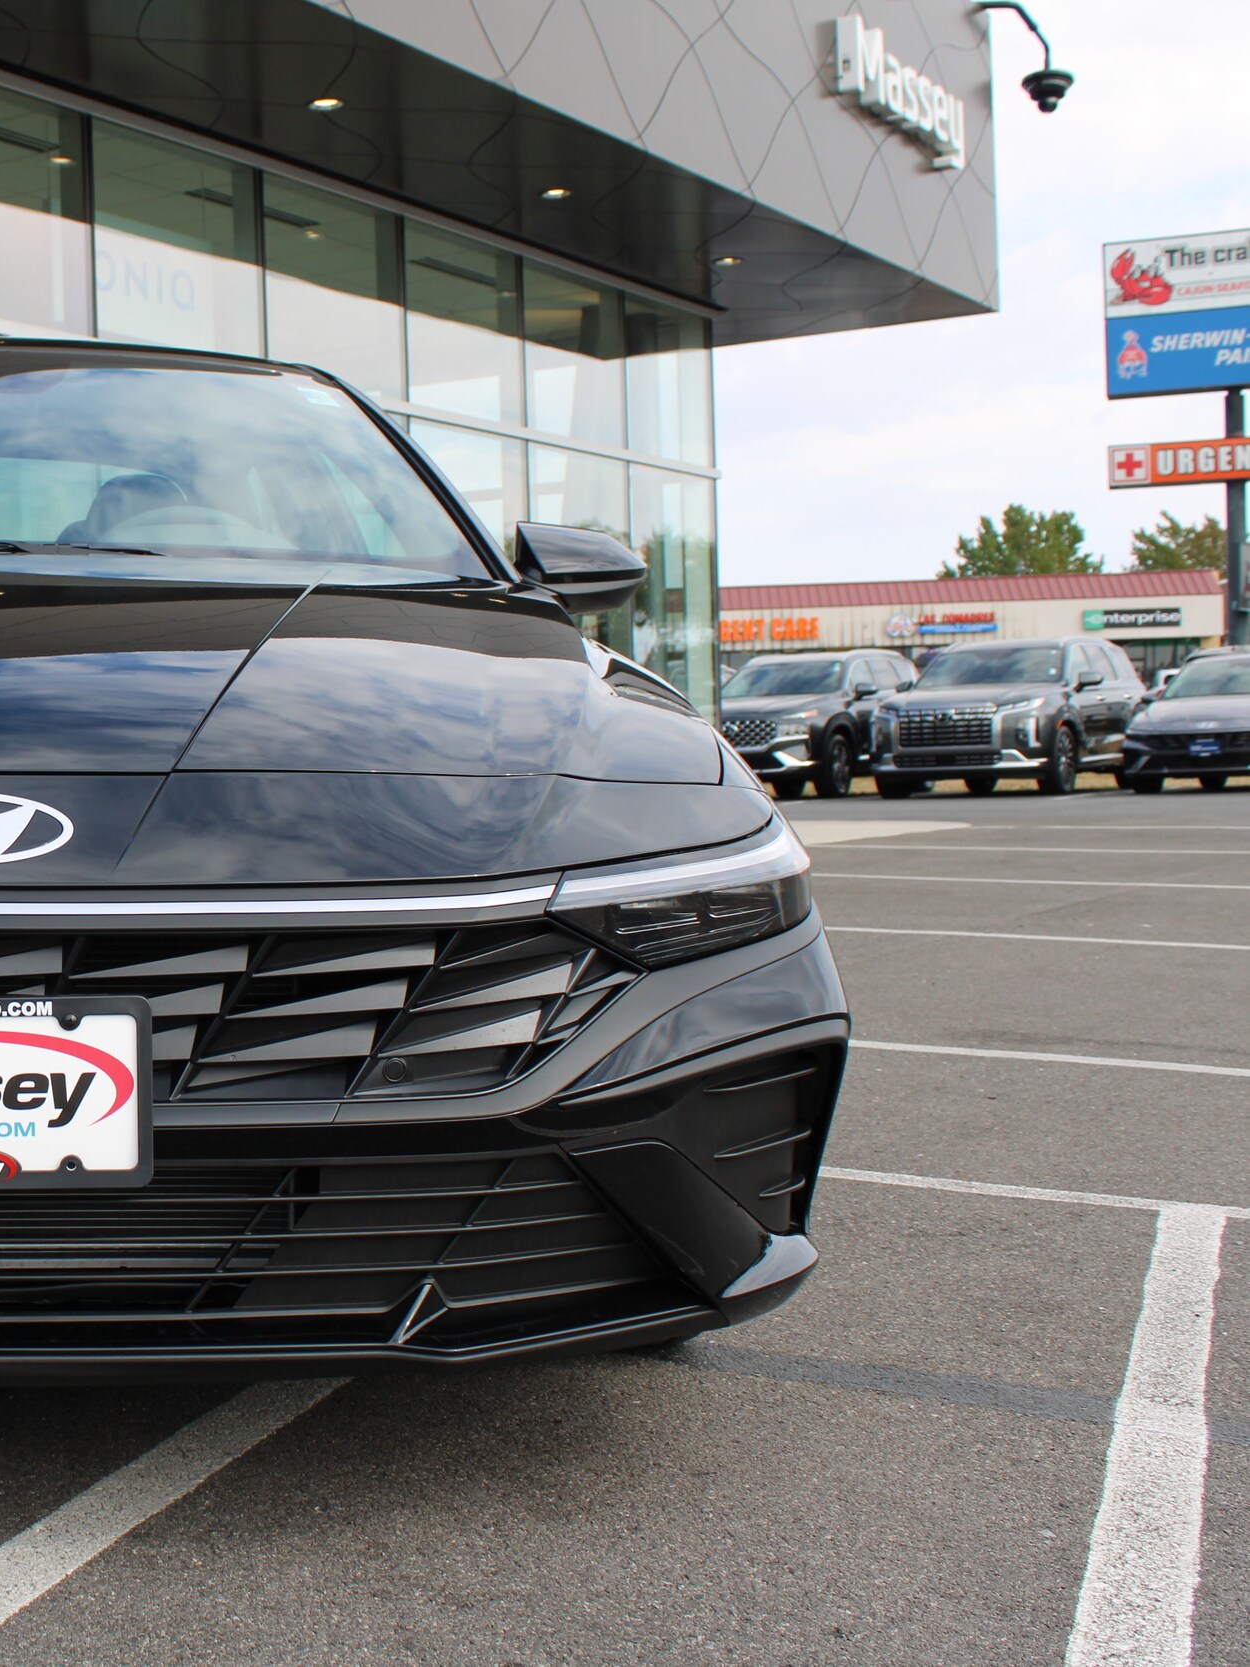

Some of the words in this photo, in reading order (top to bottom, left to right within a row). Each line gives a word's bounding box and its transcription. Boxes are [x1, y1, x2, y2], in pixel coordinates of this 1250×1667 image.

[836, 13, 966, 170] Massey
[1165, 247, 1206, 267] The
[1214, 243, 1250, 263] cra
[1177, 284, 1214, 297] CAJUN
[1156, 444, 1250, 476] URGEN
[770, 616, 819, 640] CARE
[1091, 610, 1181, 625] enterprise
